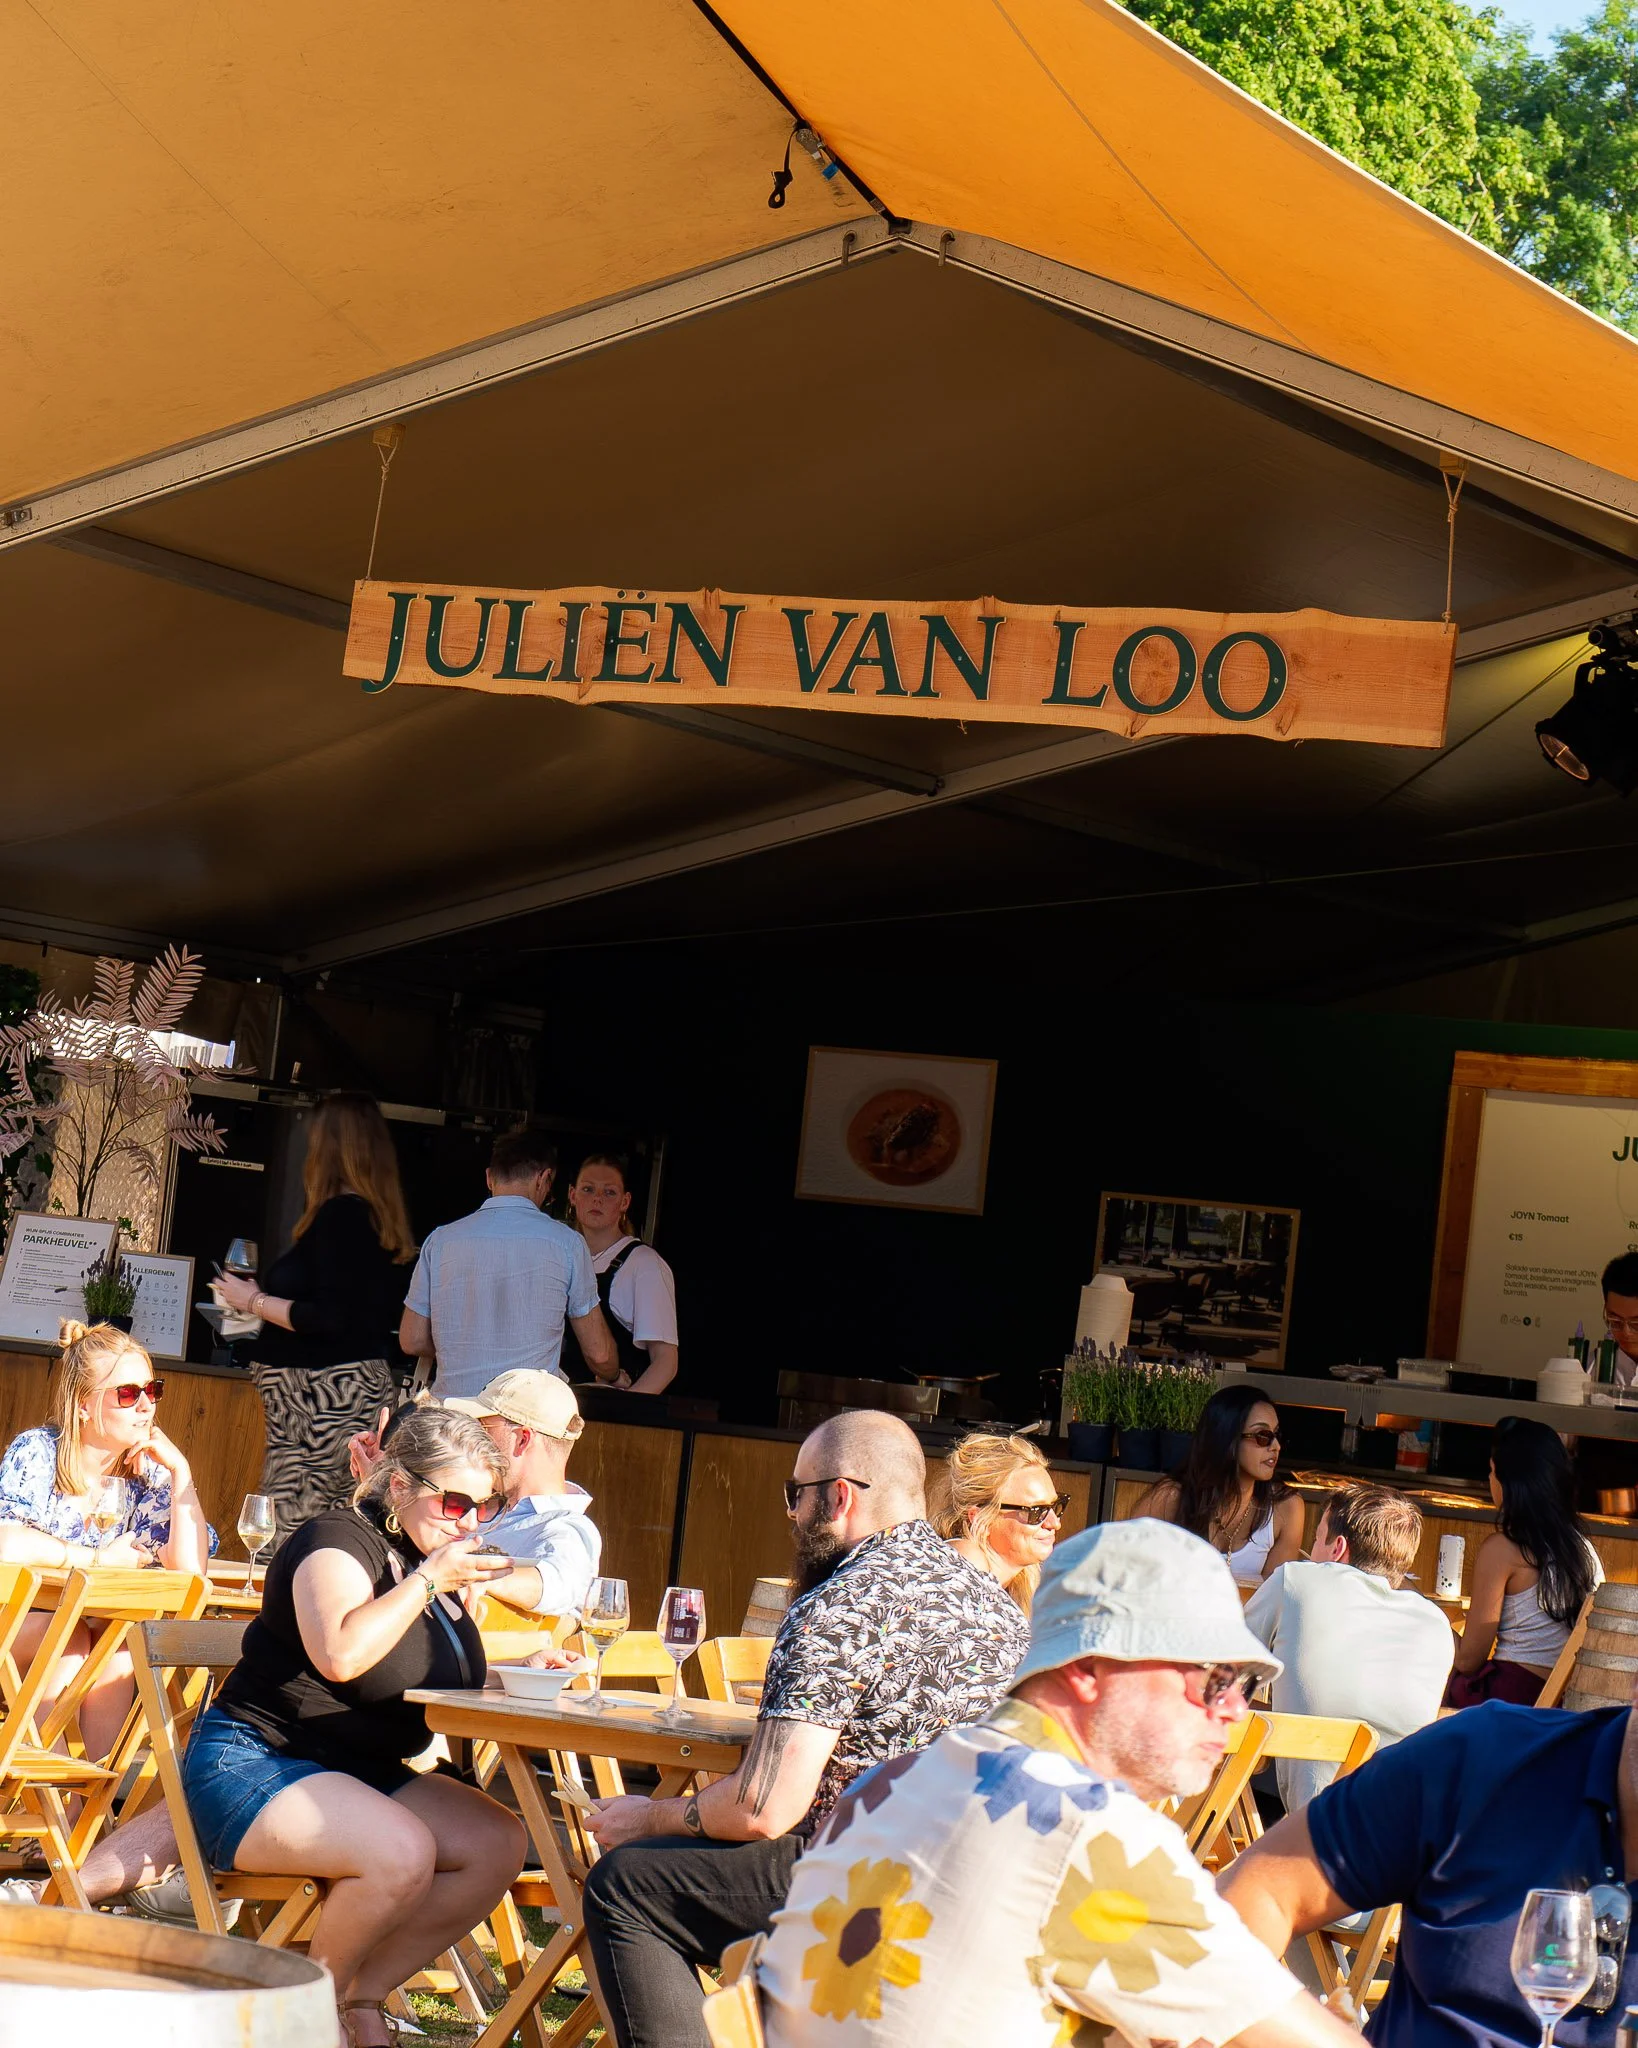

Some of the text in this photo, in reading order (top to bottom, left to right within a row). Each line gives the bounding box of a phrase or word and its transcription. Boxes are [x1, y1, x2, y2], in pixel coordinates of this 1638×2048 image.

[361, 589, 1289, 722] JULIËN VAN LOO
[1510, 1210, 1570, 1224] JOYN Tomaat
[1508, 1232, 1524, 1242] €15
[132, 1267, 176, 1278] ALLERGENEN
[1505, 1263, 1528, 1272] Salade
[1564, 1269, 1577, 1277] met
[1529, 1274, 1560, 1283] basilicum
[1504, 1280, 1523, 1288] Dutch
[1548, 1284, 1568, 1292] pesto
